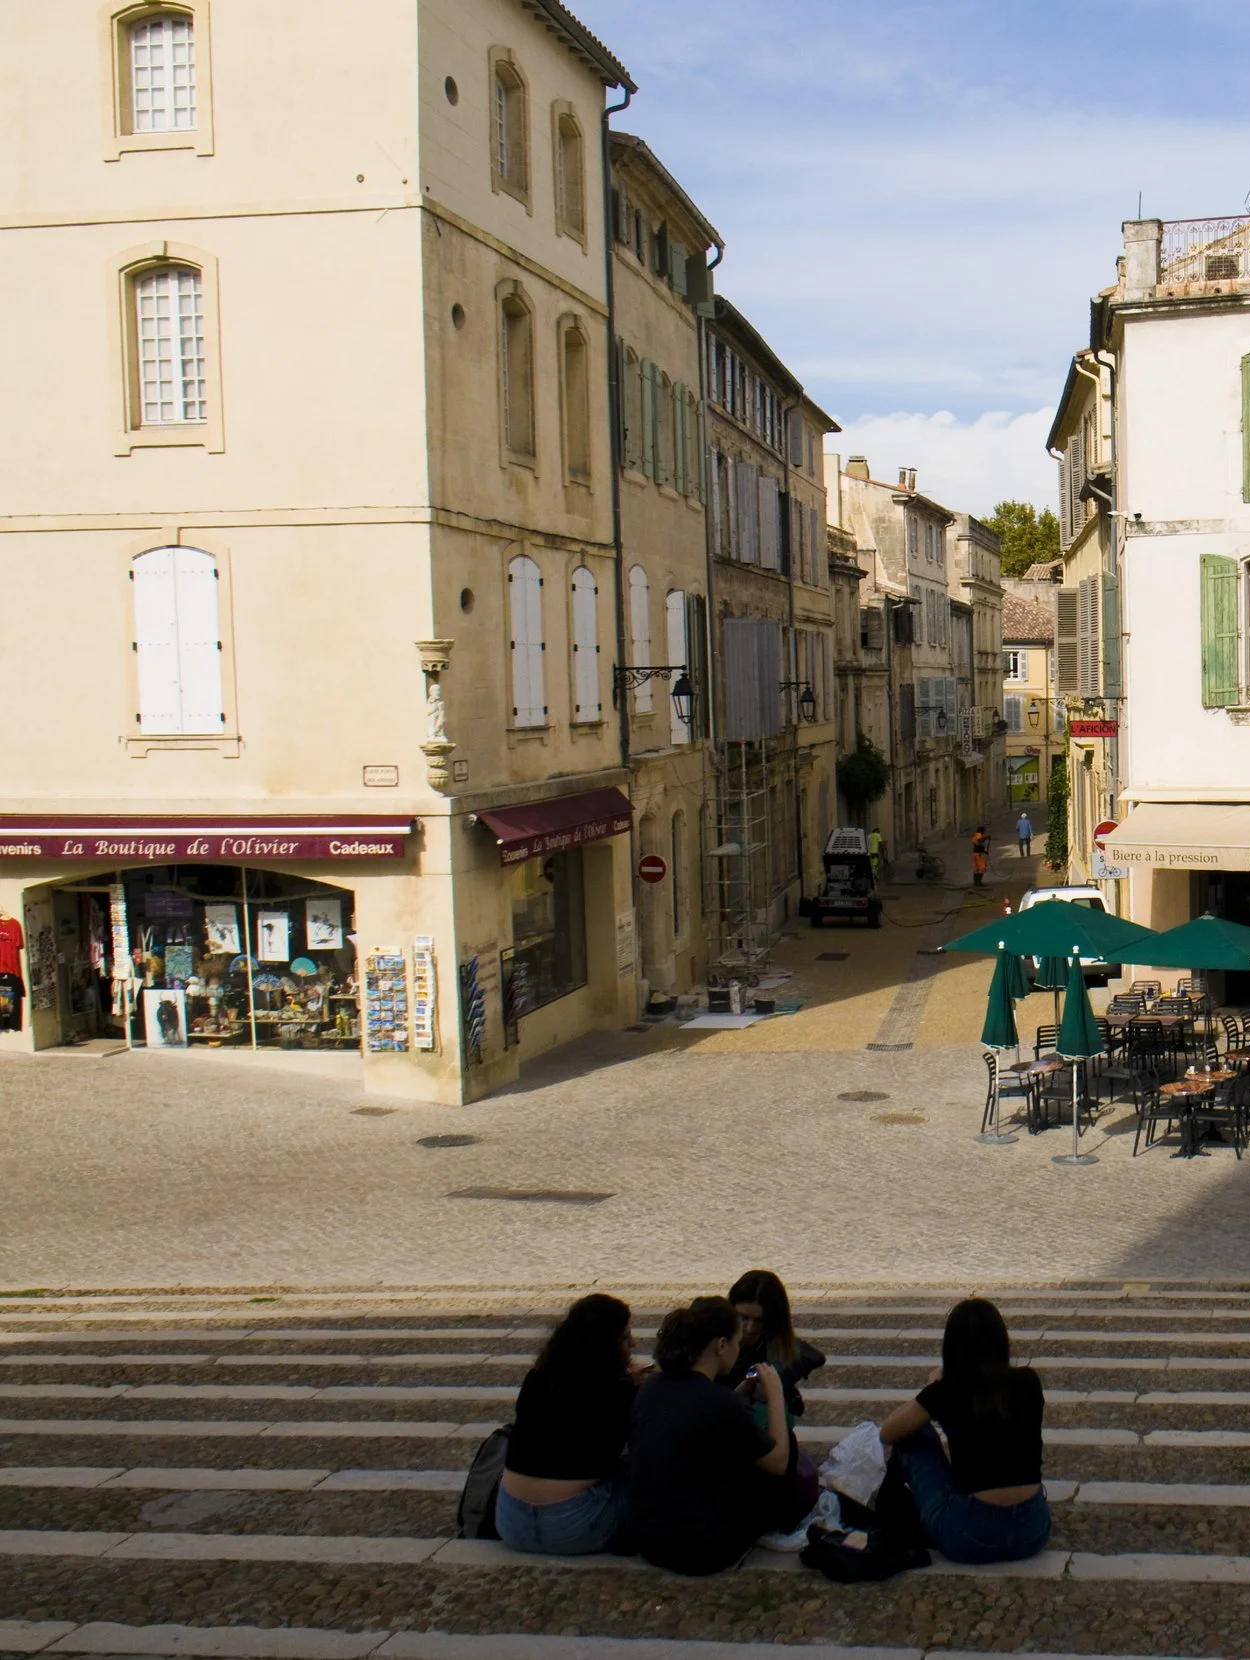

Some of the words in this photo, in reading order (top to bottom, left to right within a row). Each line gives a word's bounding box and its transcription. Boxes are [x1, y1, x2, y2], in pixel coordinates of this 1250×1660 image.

[1071, 723, 1117, 734] L'AFICION
[0, 842, 42, 856] venirs
[61, 839, 84, 855] La
[95, 839, 176, 859] Boutique
[186, 838, 209, 855] de
[220, 837, 299, 855] l'Olivier
[329, 840, 394, 855] Cadeaux
[1144, 852, 1151, 862] à
[1154, 852, 1166, 863] la
[1169, 853, 1219, 865] pression
